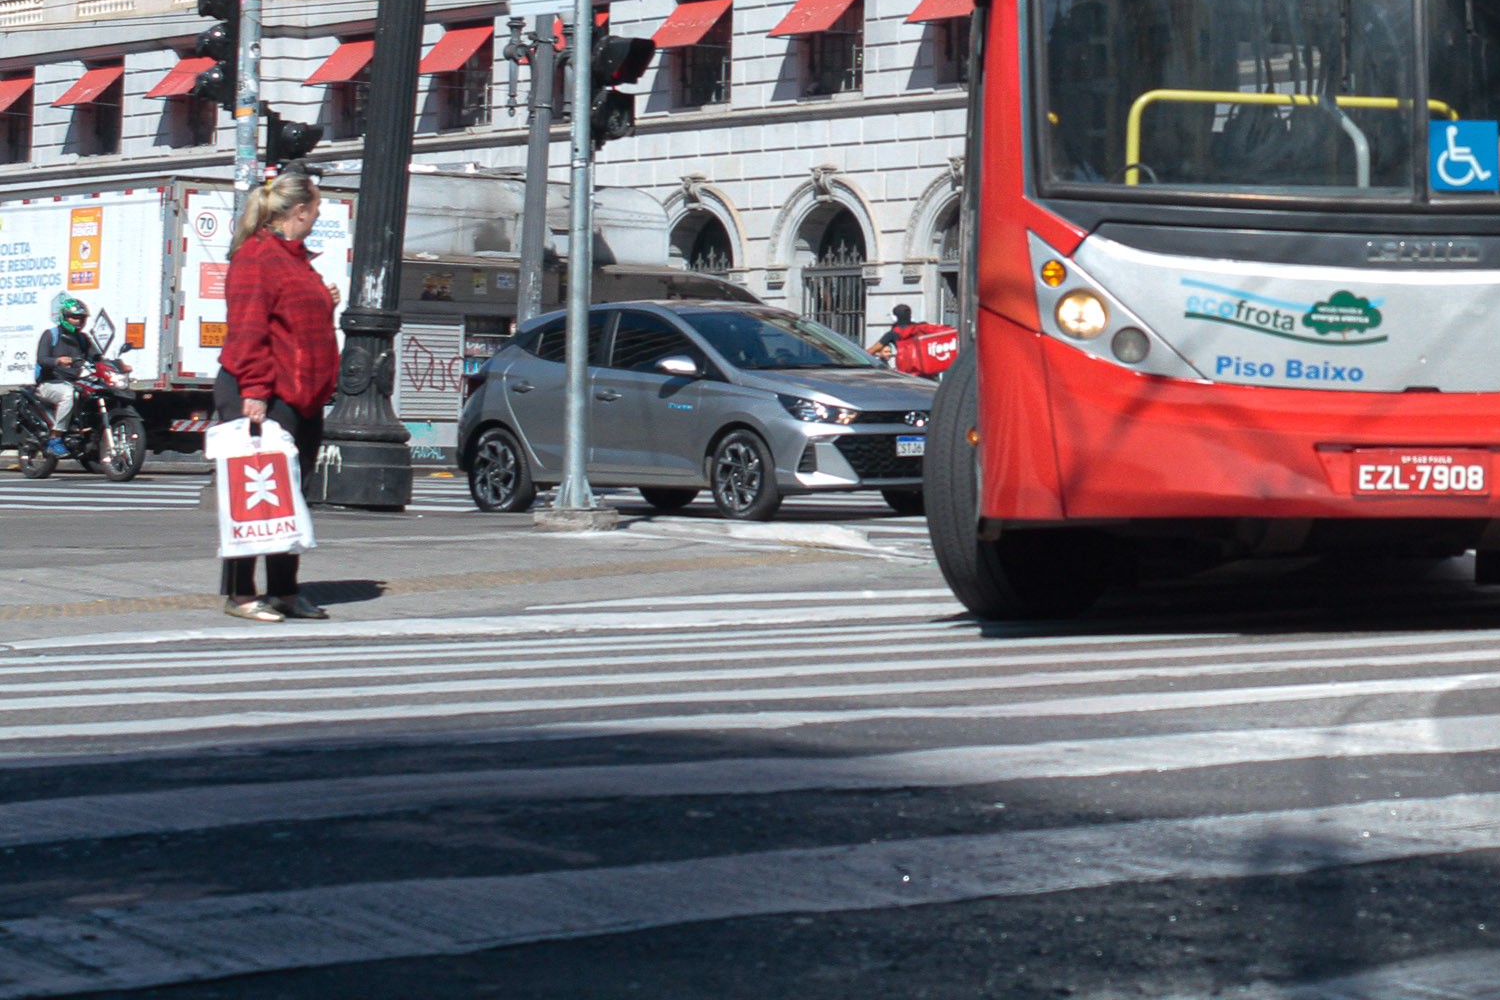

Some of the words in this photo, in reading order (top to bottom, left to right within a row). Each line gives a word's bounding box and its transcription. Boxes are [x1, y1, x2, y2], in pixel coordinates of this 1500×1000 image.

[199, 217, 214, 231] 70
[0, 241, 31, 256] OLETA
[7, 254, 57, 272] RESÍDUOS
[14, 272, 62, 290] SERVIÇOS
[6, 289, 38, 306] SAÚDE
[1186, 293, 1295, 331] ecofrota
[1215, 356, 1275, 379] Piso
[1285, 358, 1364, 383] Baixo
[232, 520, 297, 539] KALLAN
